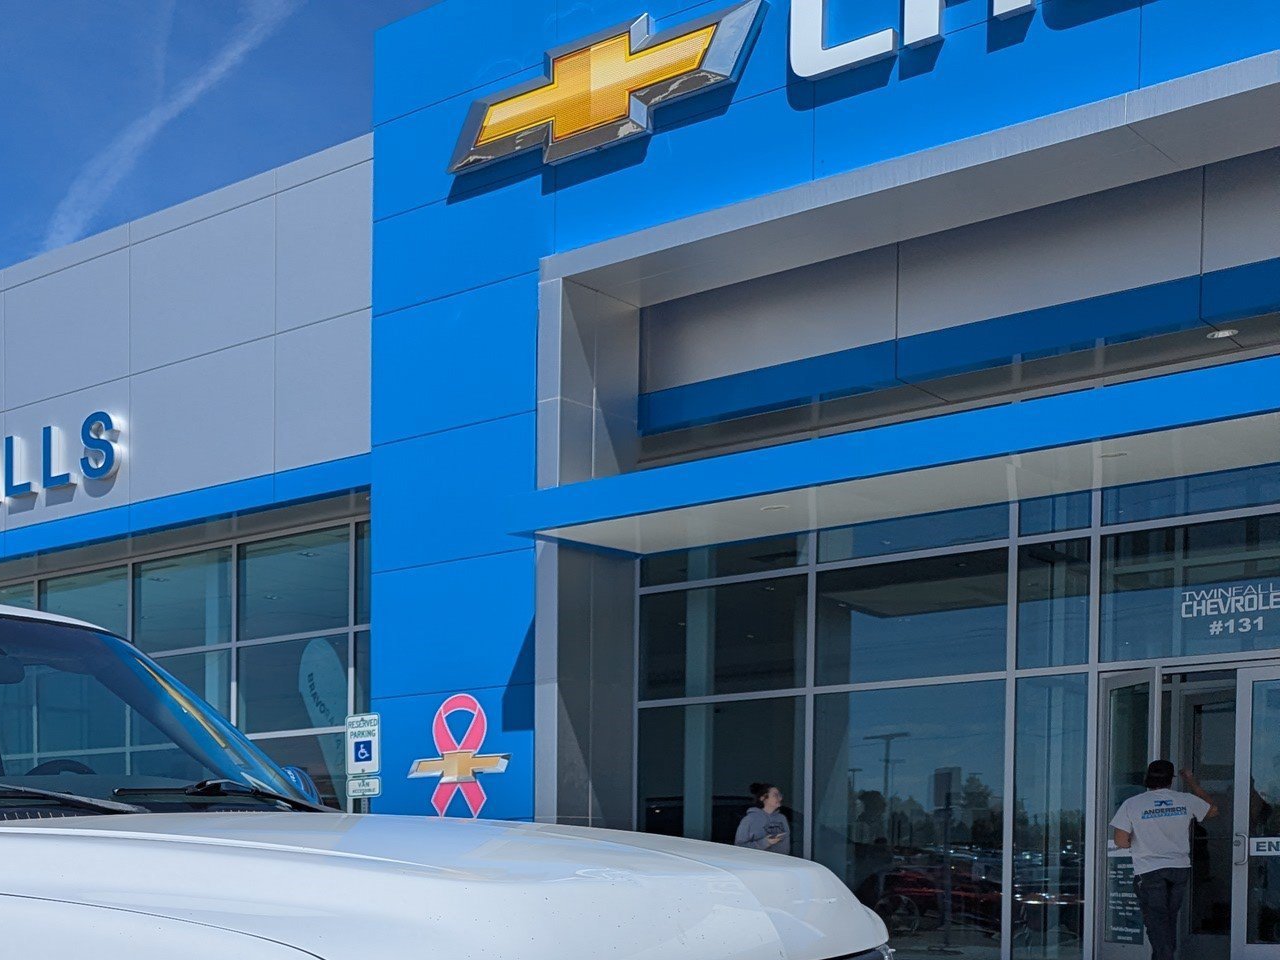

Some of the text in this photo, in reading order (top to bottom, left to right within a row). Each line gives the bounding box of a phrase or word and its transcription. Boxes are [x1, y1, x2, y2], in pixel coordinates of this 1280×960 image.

[1181, 592, 1280, 618] CHEVROLE
[1209, 616, 1264, 635] #131
[348, 719, 378, 729] RESERVED
[350, 730, 376, 739] PARKING
